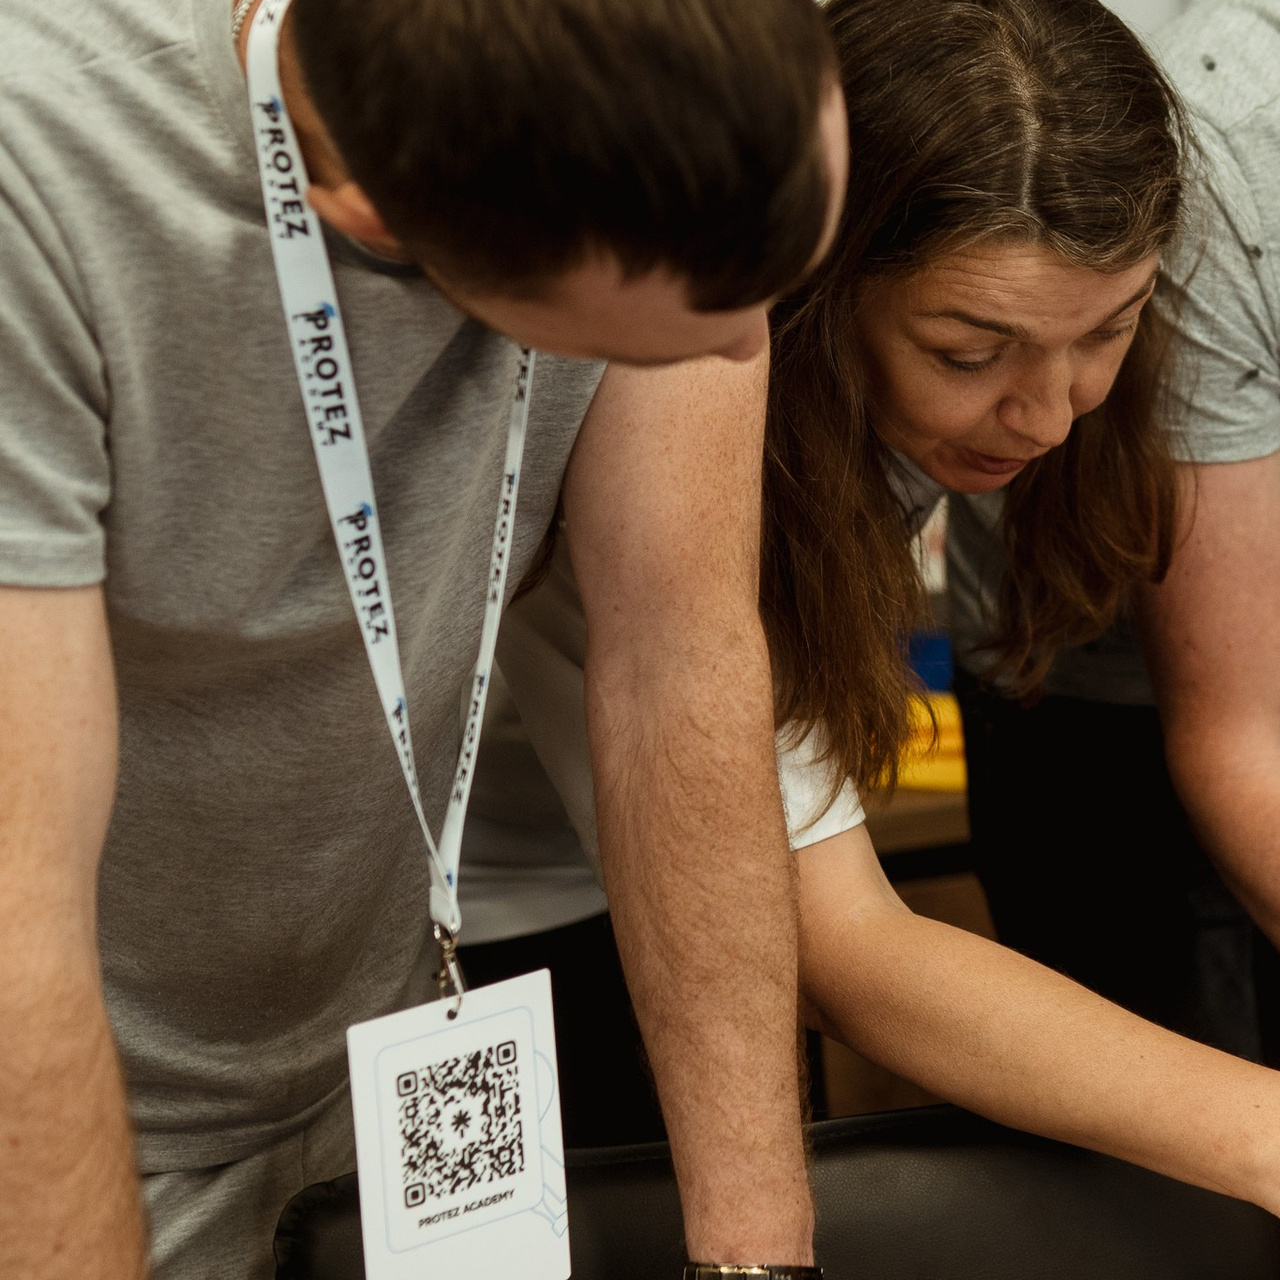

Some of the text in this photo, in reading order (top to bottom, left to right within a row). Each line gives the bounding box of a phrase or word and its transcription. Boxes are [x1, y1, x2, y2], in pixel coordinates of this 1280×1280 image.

[257, 97, 311, 238] PROTEZ
[293, 307, 351, 442] PROTEZ
[339, 507, 389, 639] PROTEZ
[418, 1188, 515, 1229] PROTEZ ACADEMY
